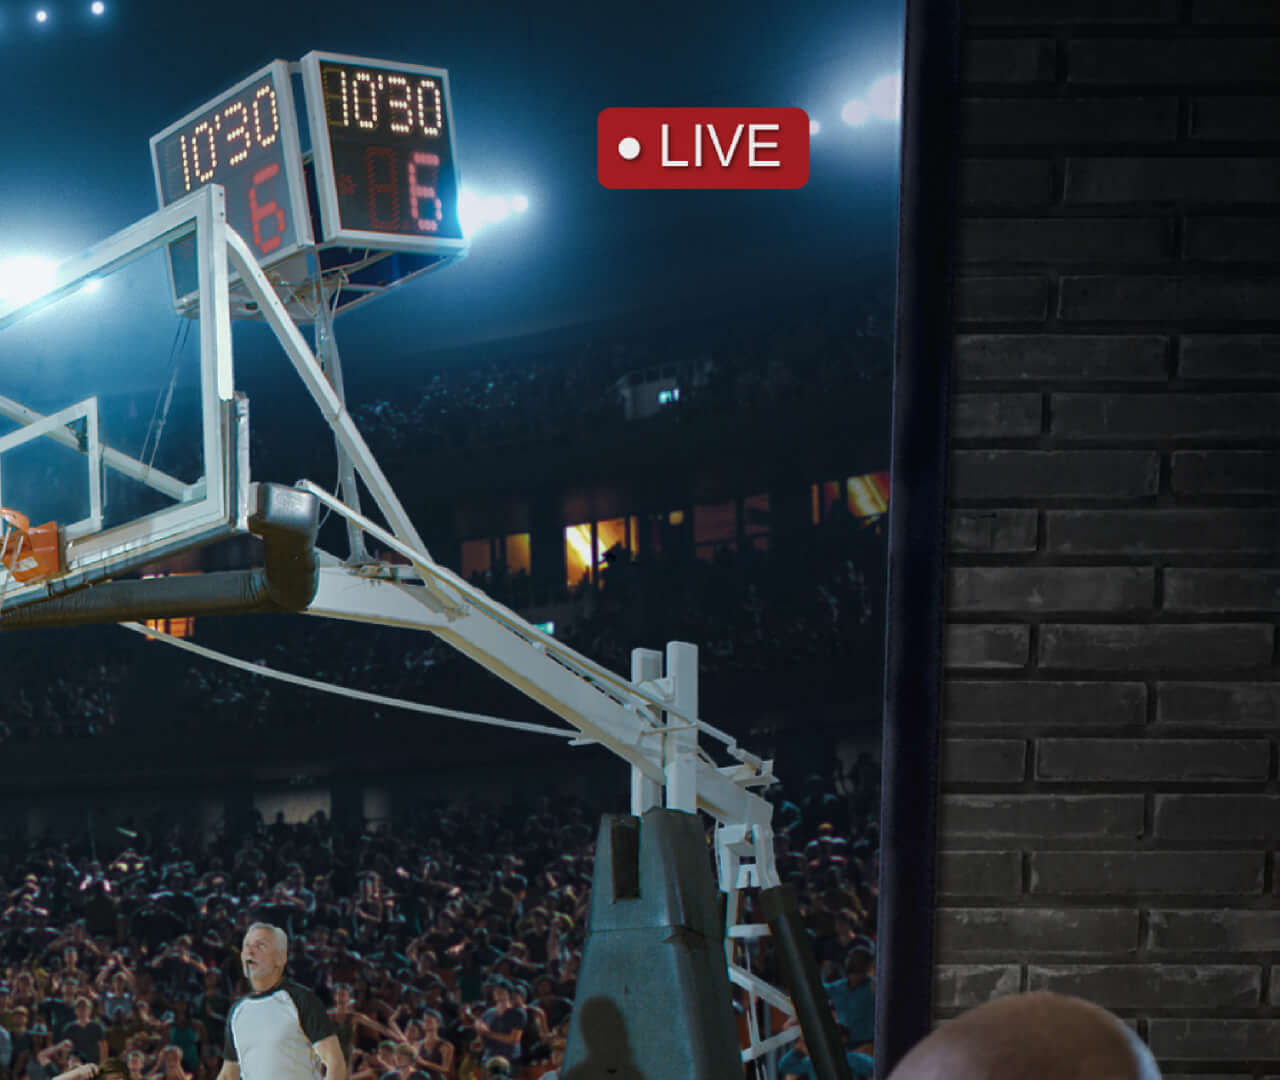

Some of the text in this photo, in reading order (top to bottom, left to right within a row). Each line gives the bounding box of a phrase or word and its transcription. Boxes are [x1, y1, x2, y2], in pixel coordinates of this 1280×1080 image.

[661, 123, 781, 167] LIVE
[248, 162, 286, 254] 6
[408, 152, 443, 231] 6
